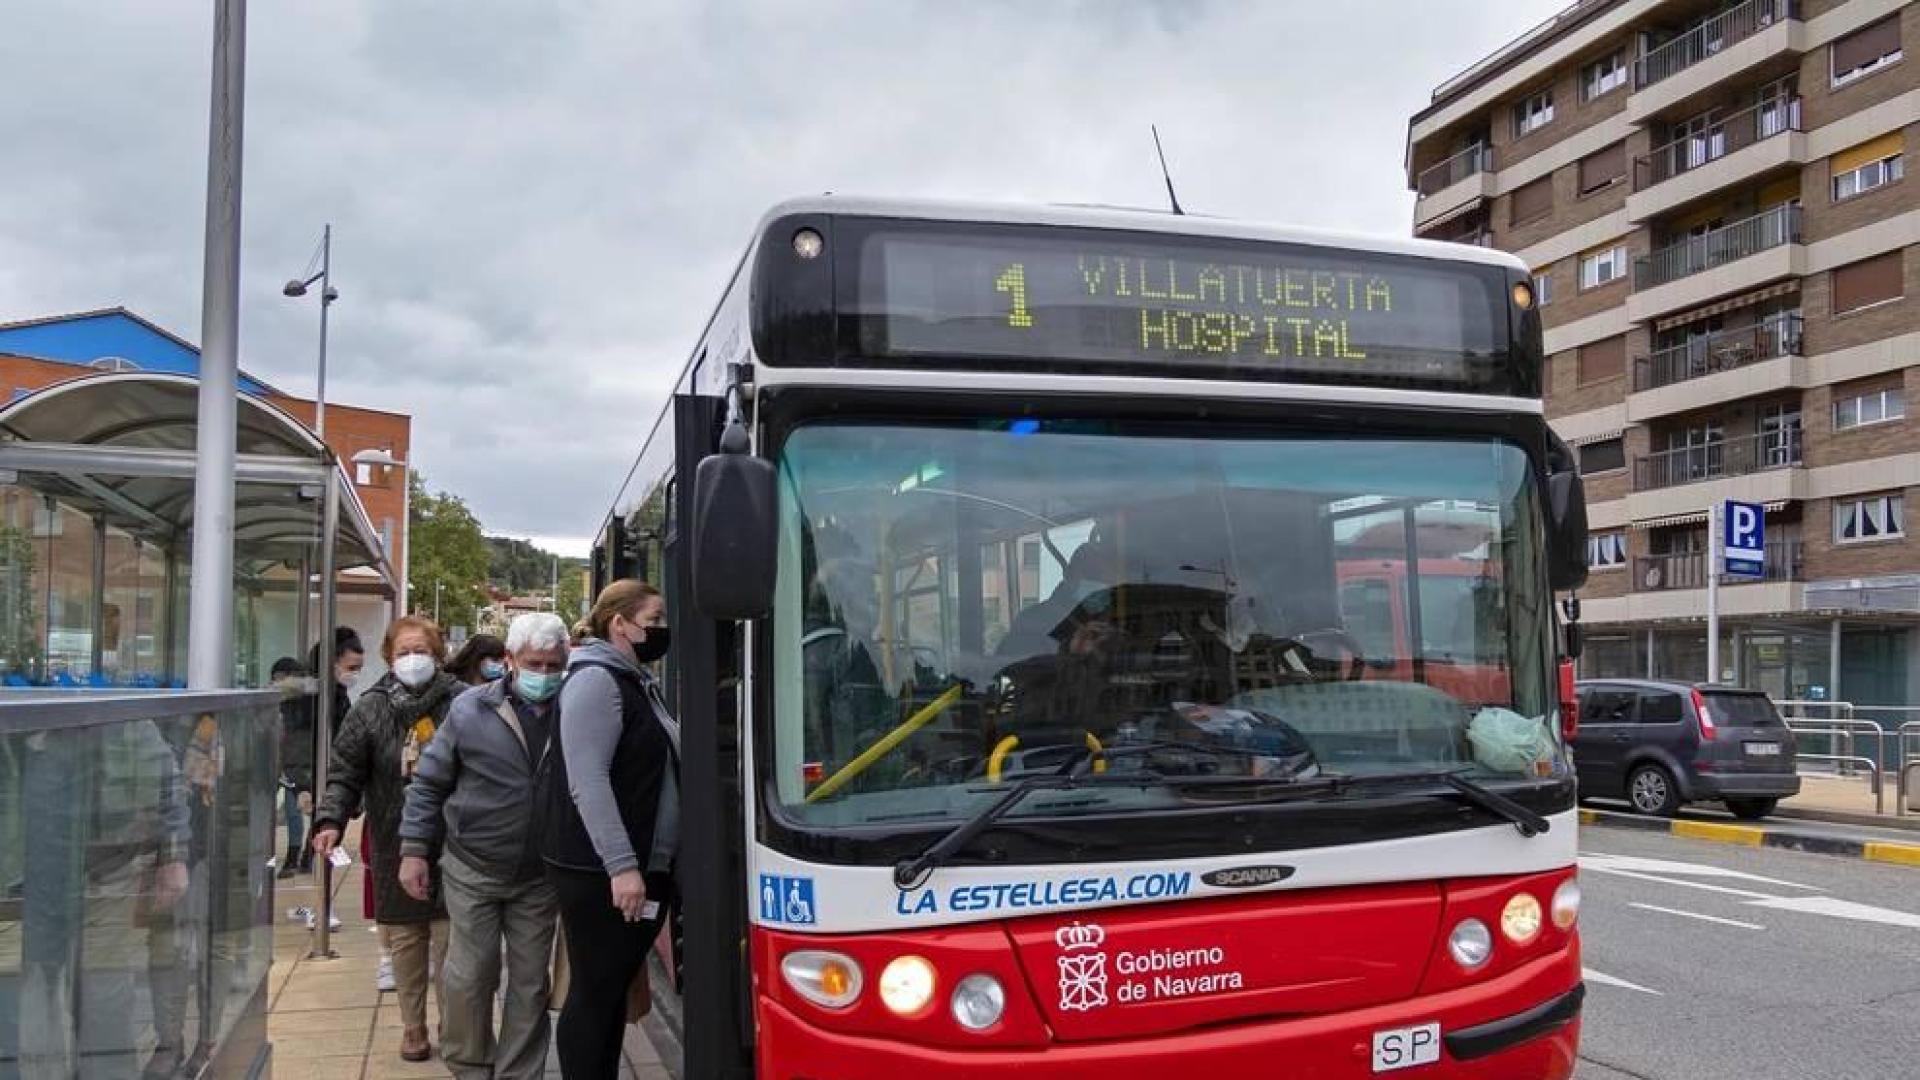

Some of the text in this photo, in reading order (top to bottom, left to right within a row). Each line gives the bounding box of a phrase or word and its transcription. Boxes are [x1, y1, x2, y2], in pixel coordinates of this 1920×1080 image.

[996, 262, 1033, 327] 1
[1076, 253, 1392, 312] VILLATUERTA
[1141, 309, 1367, 359] HOSPITAL
[1733, 505, 1756, 546] P
[896, 872, 1192, 915] LA ESTELLESA.COM
[1214, 866, 1283, 886] SCANIA
[1116, 945, 1225, 976] Gobierno
[1117, 967, 1244, 1003] de Navarra
